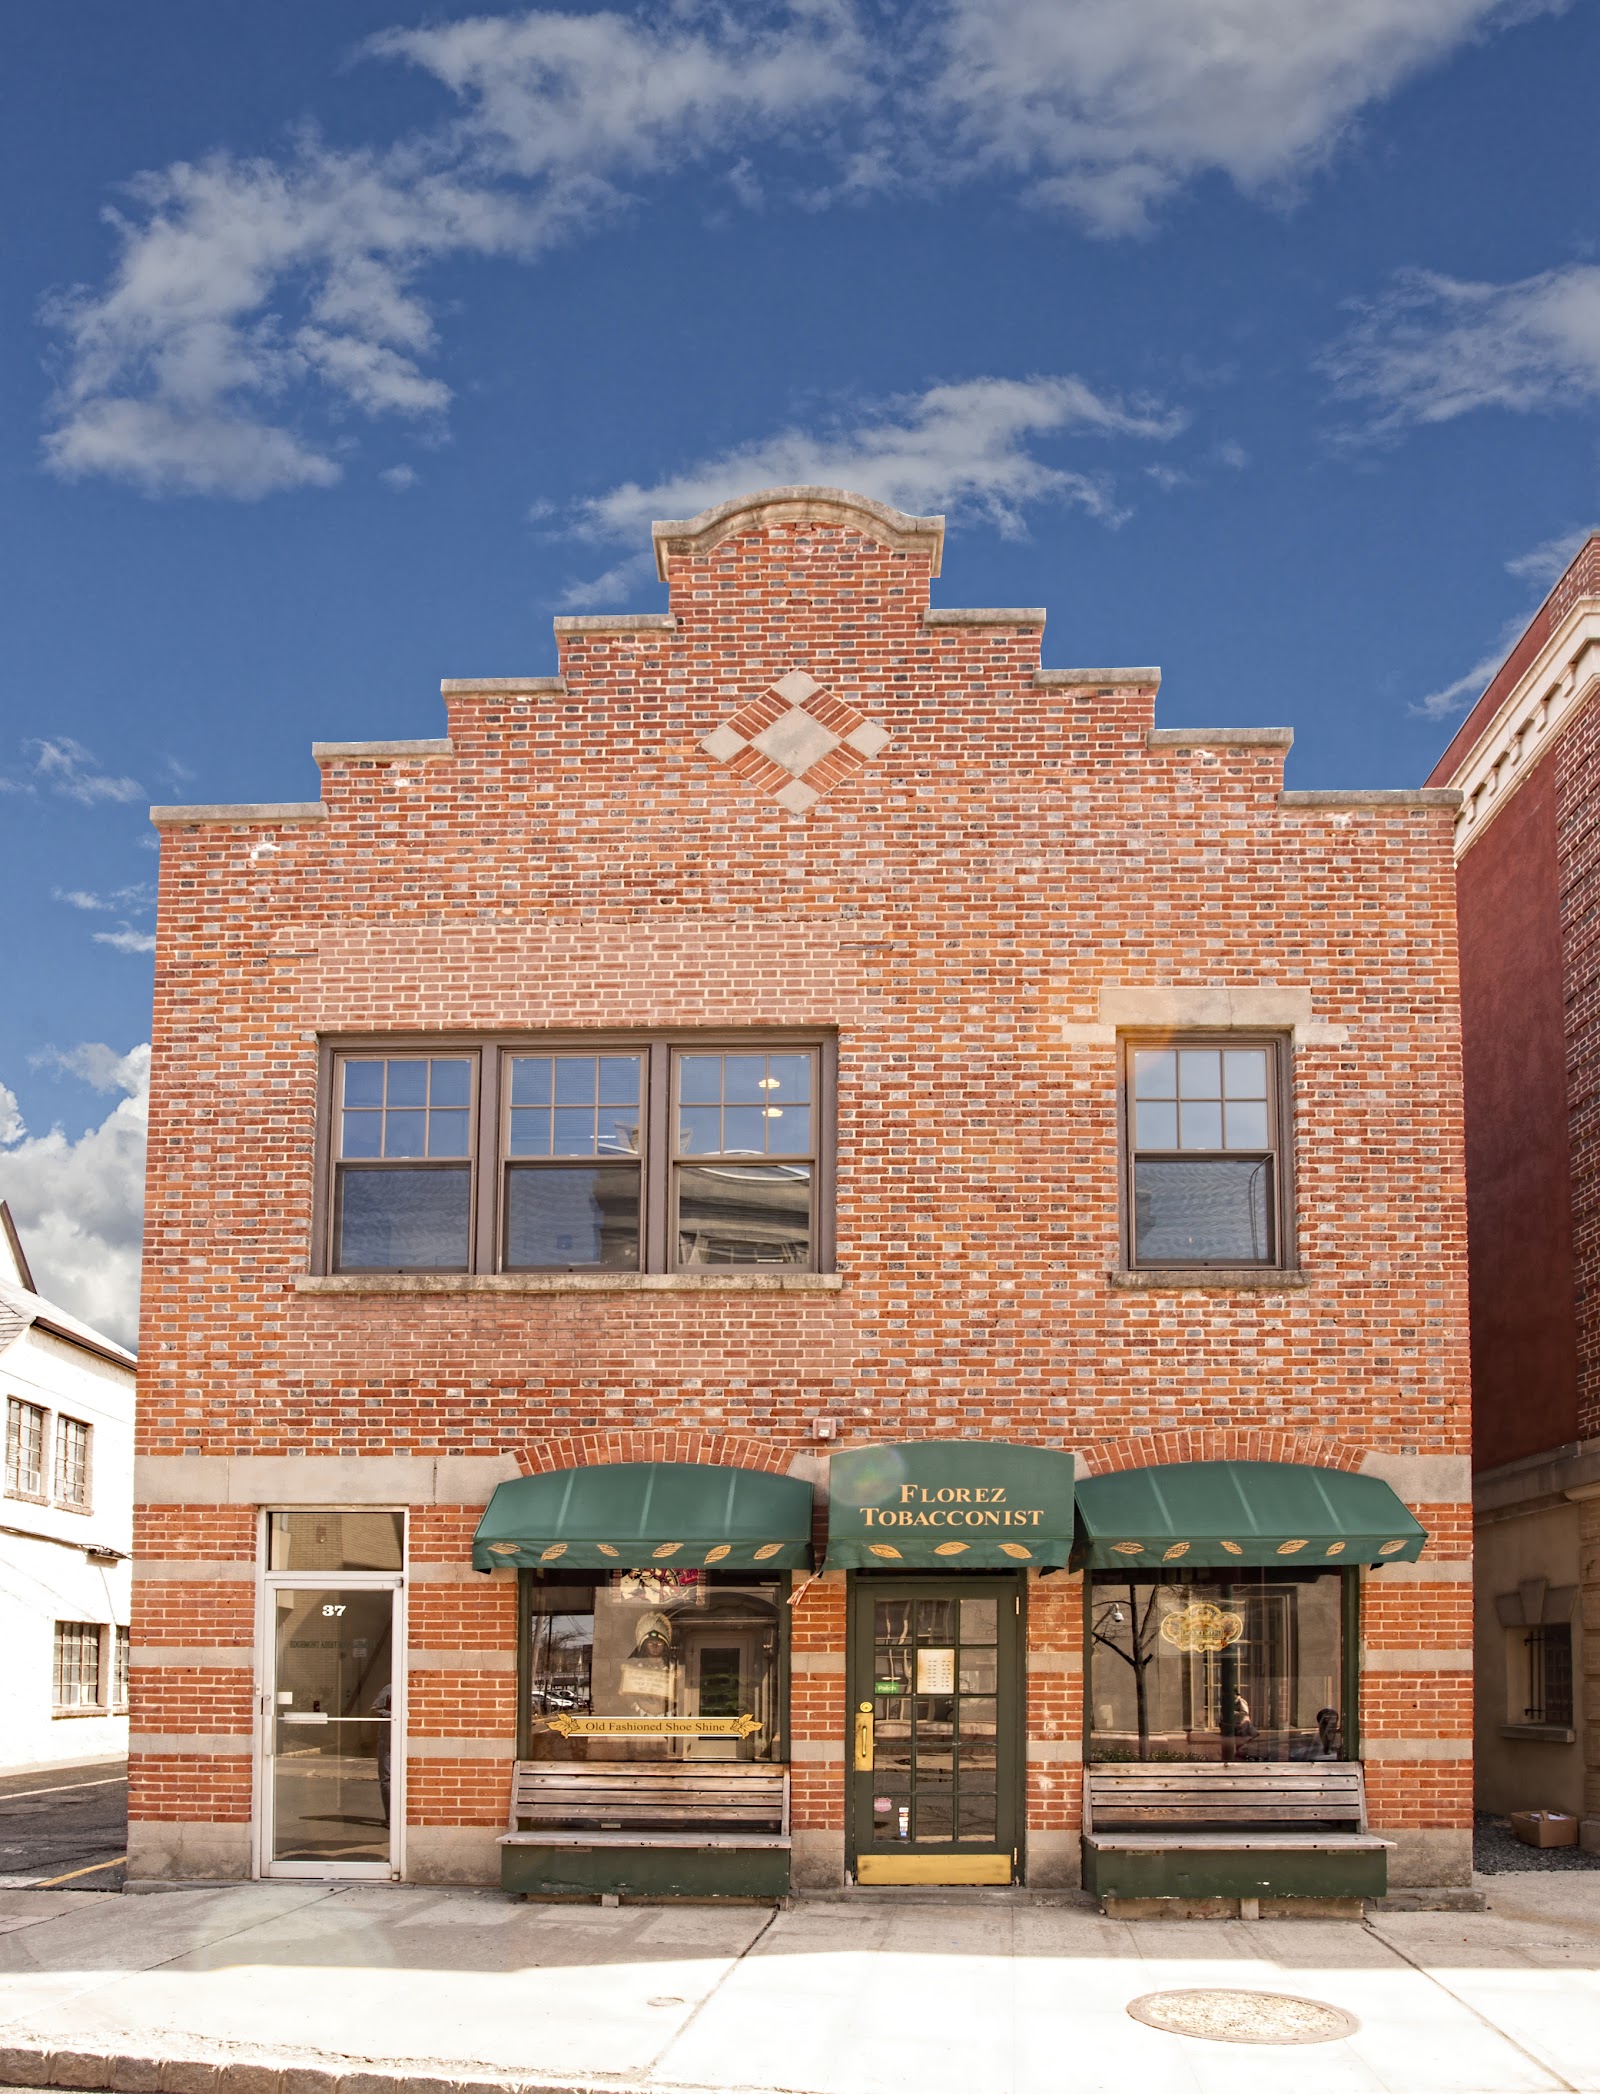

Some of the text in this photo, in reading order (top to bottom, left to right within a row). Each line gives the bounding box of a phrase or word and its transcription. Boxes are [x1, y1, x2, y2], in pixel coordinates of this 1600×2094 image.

[322, 1604, 346, 1616] 37
[585, 1721, 725, 1731] Old Fashioned Shoe Shine
